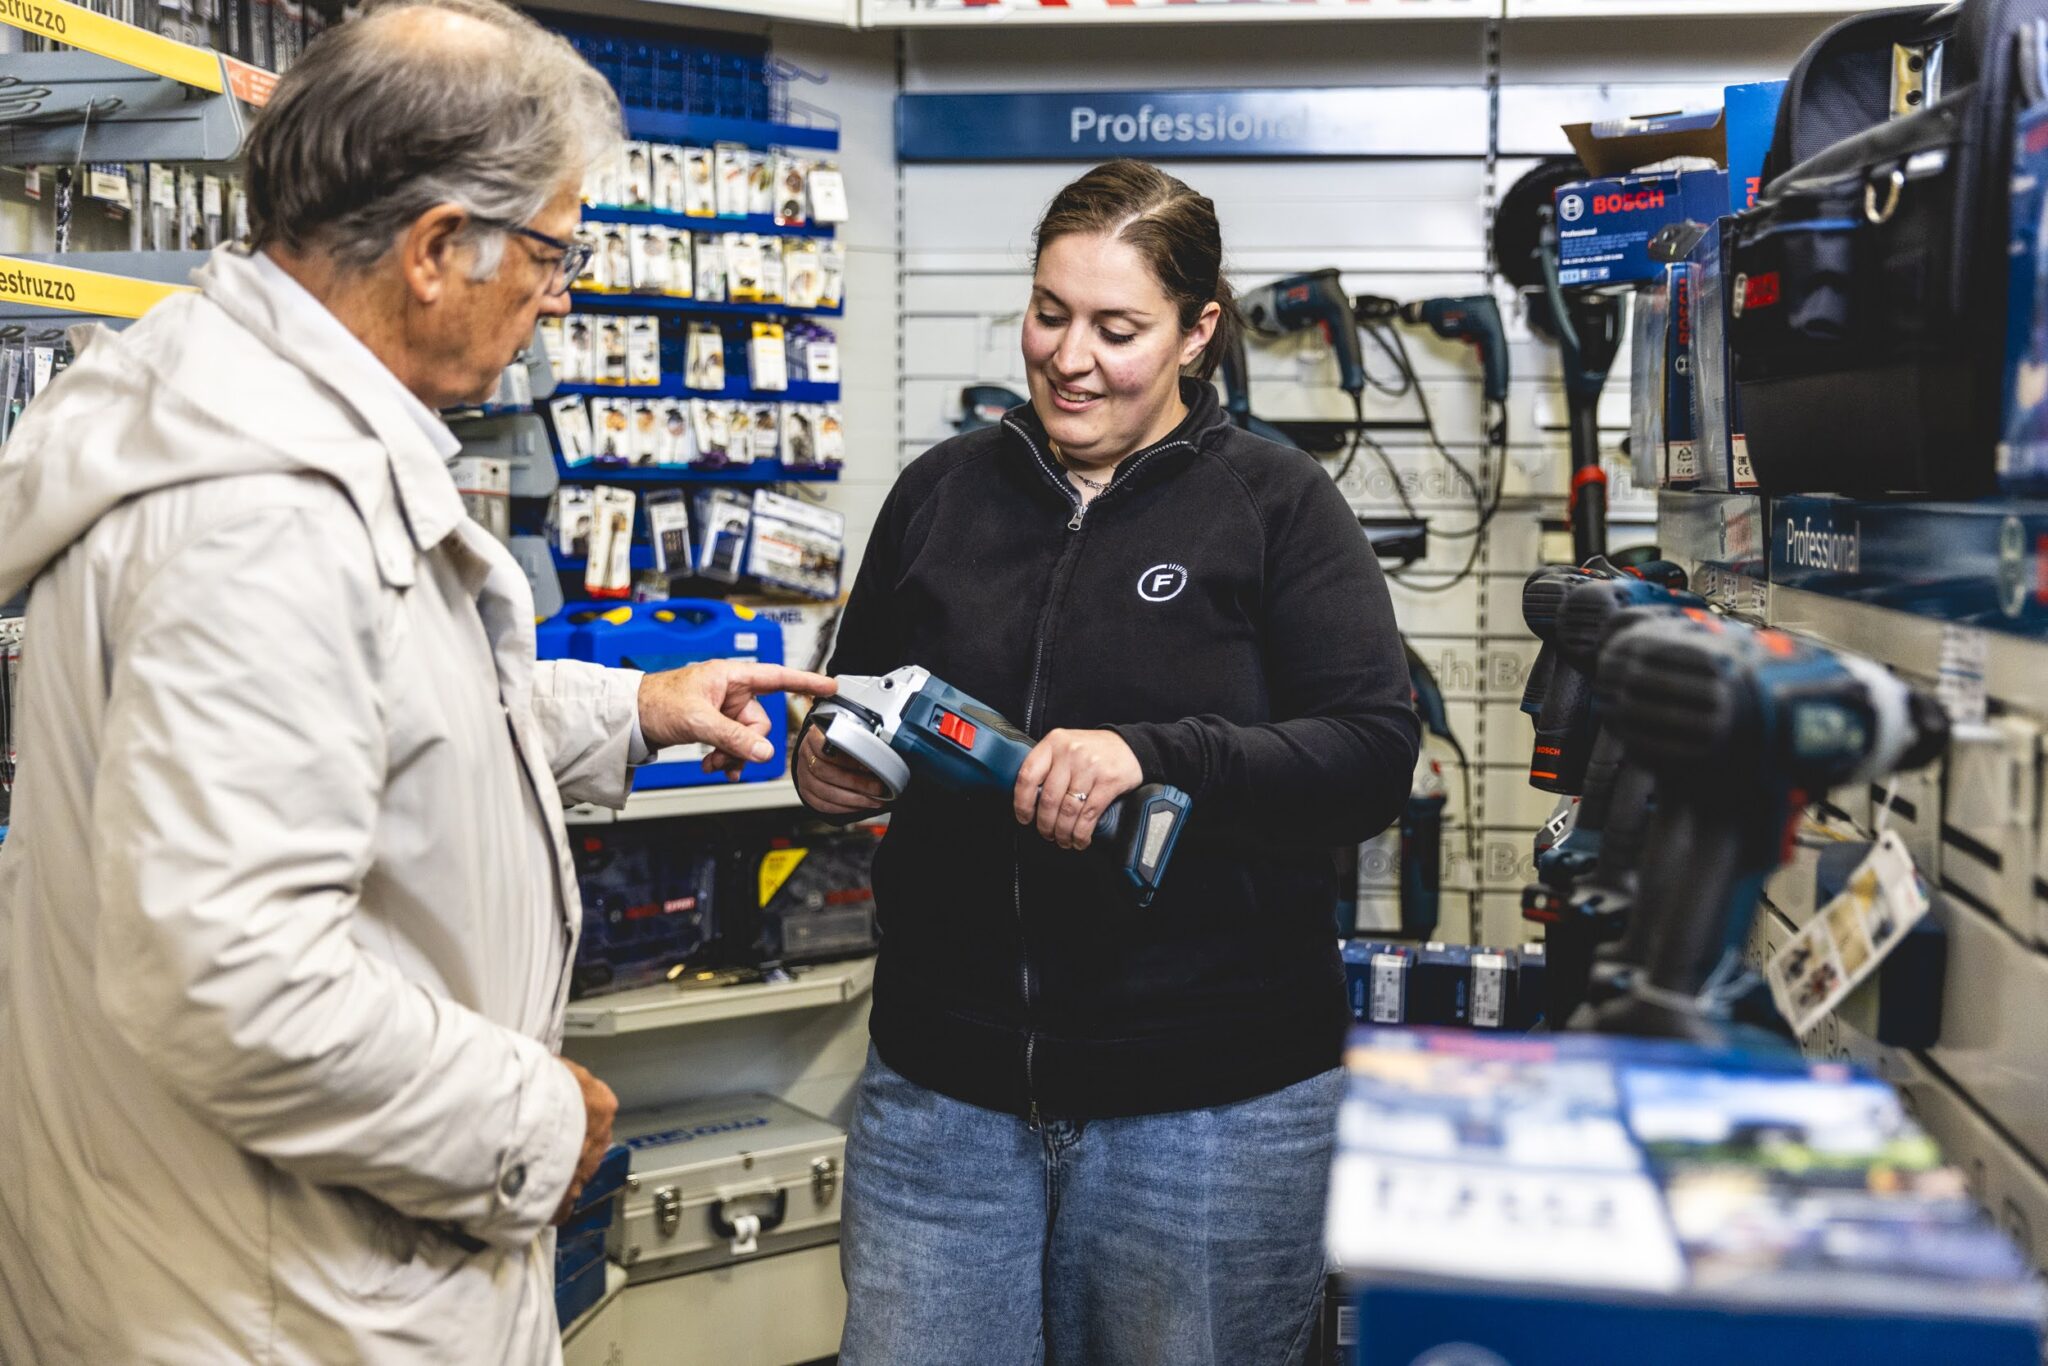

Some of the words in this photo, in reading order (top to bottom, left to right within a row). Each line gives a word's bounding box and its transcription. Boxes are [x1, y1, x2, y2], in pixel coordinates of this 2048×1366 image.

[1593, 190, 1665, 215] BOSCH
[1786, 515, 1860, 575] Professional
[1152, 574, 1174, 592] F
[1536, 745, 1561, 756] BOSCH
